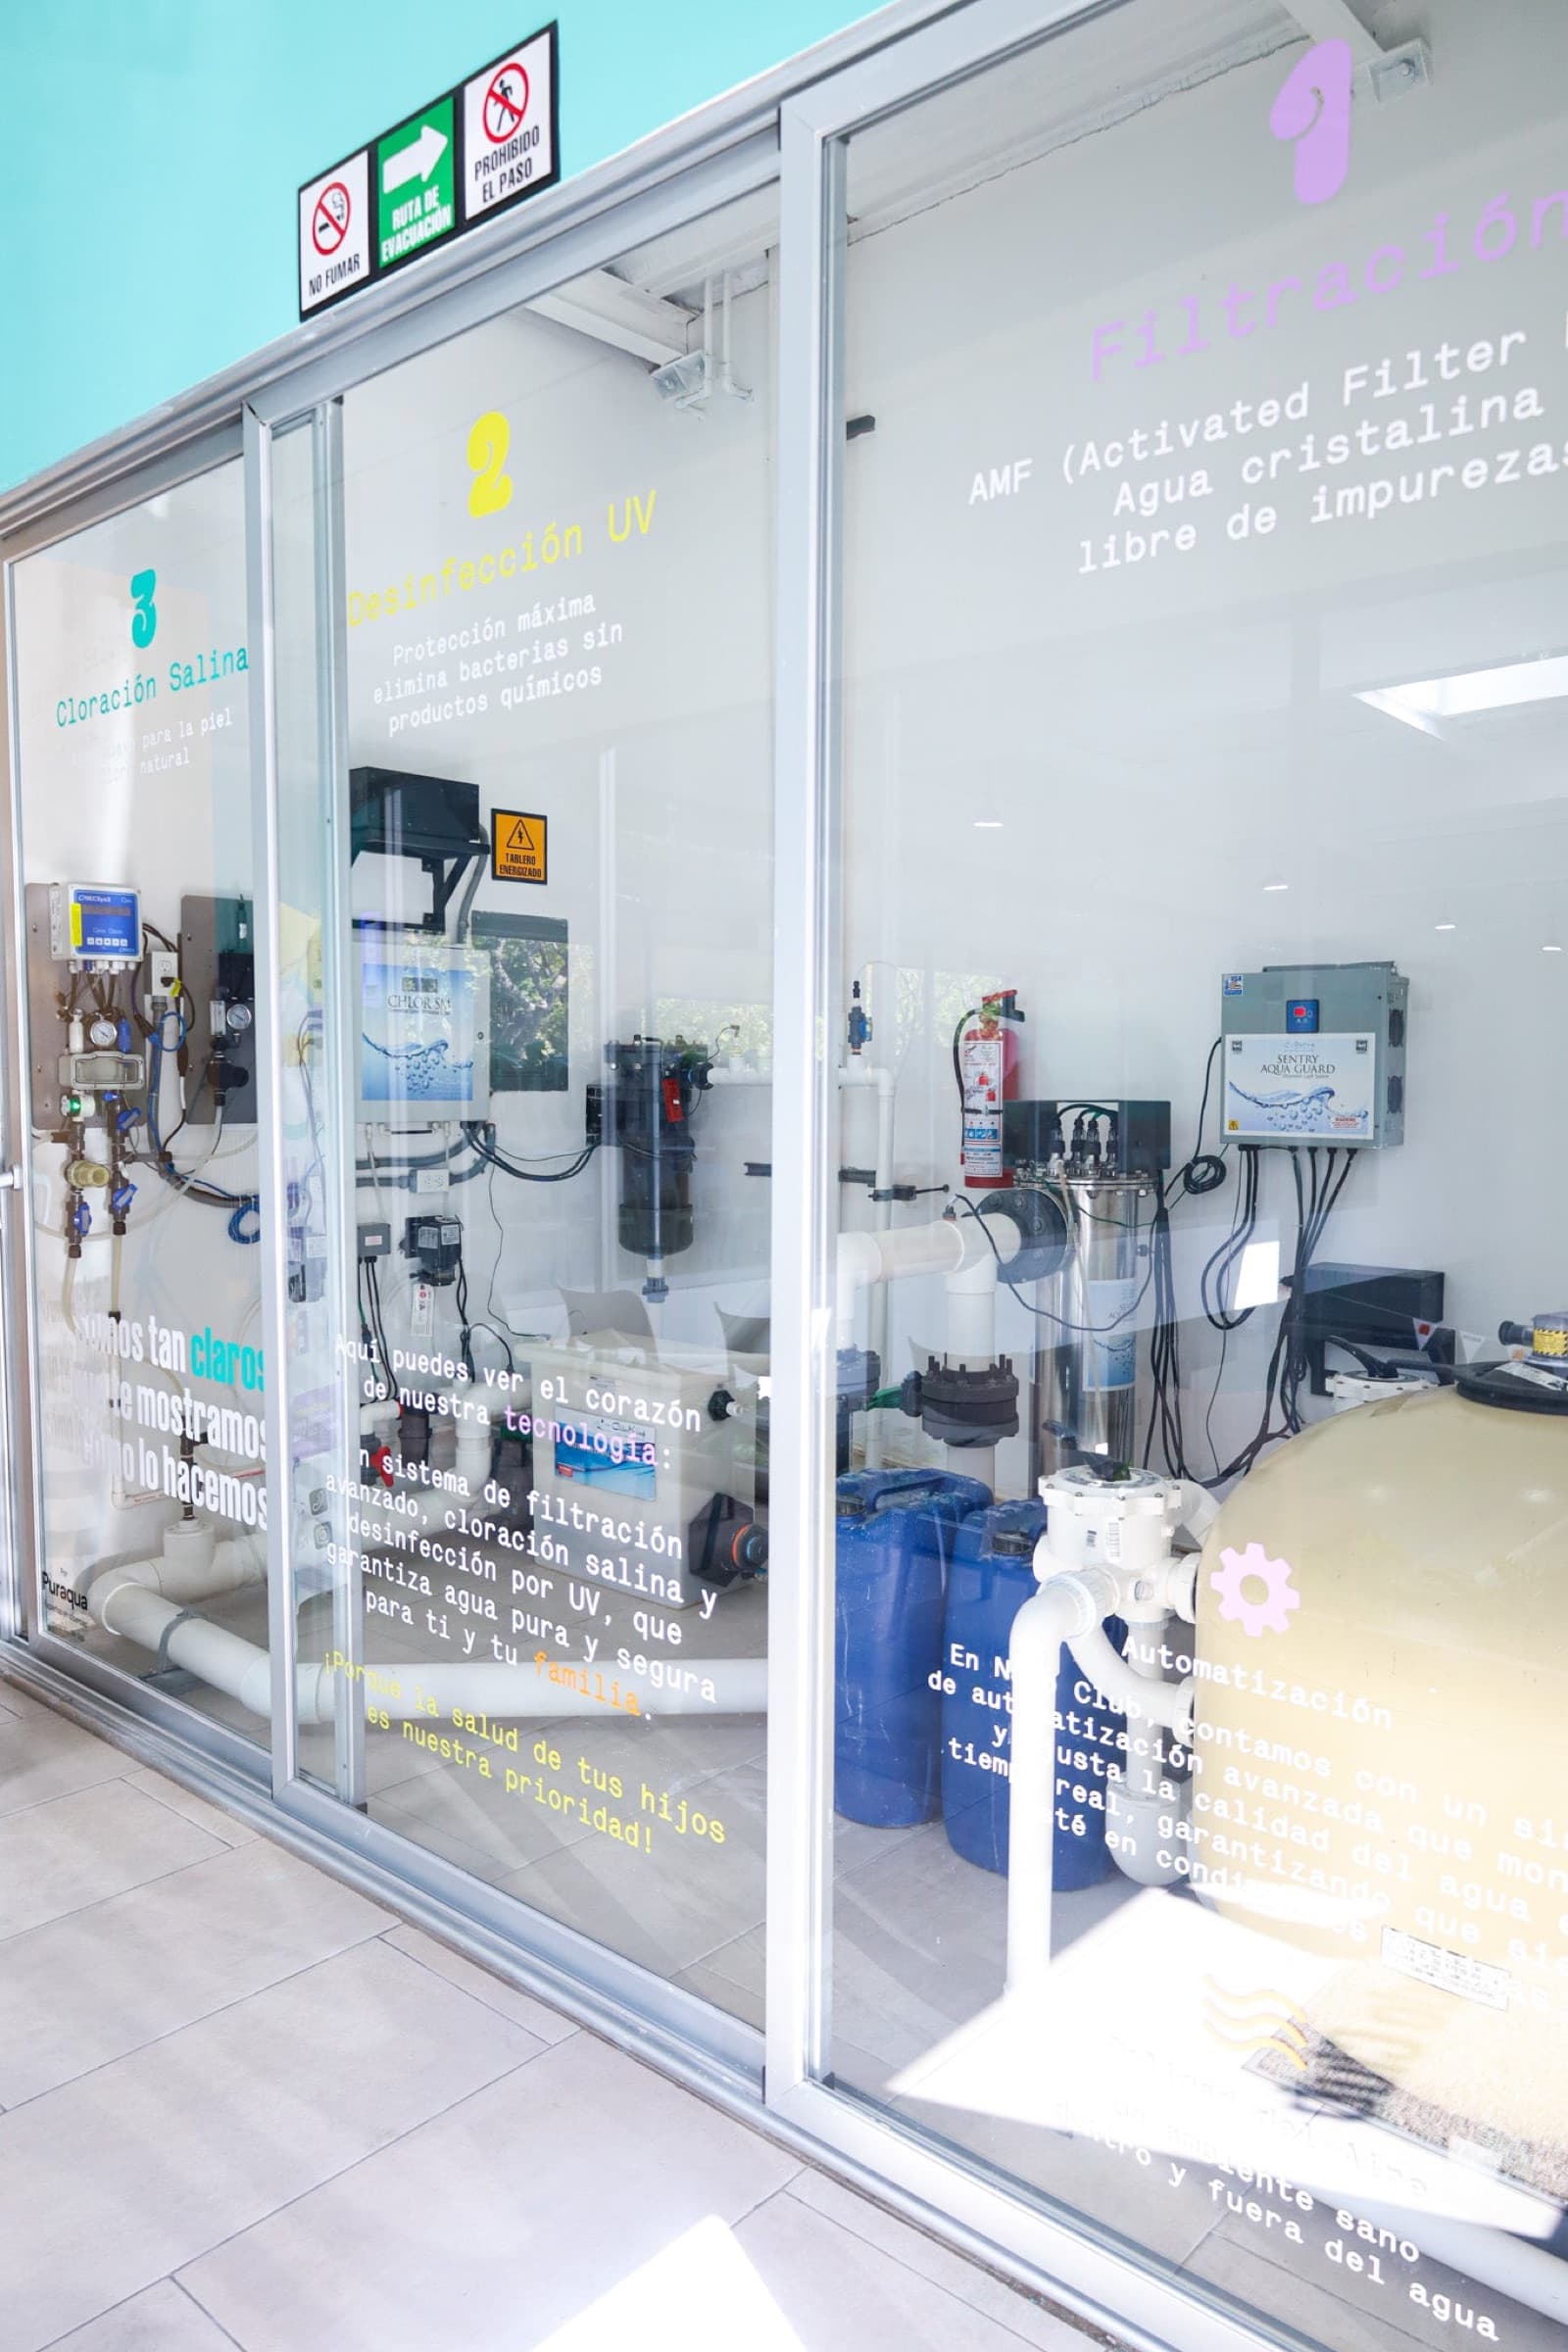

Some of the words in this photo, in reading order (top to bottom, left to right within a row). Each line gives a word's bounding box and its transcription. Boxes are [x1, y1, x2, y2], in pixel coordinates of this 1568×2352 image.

[474, 124, 540, 181] PROHIBIDO
[1271, 39, 1351, 204] 1
[393, 196, 421, 232] RUTA
[424, 184, 439, 212] DE
[483, 180, 495, 203] EL
[500, 157, 532, 197] PASO
[309, 273, 321, 297] NO
[325, 254, 360, 285] FUMAR
[382, 204, 452, 262] EVACUACIÓN
[1090, 190, 1568, 381] Filtración
[968, 459, 1033, 505] AMF
[1063, 383, 1308, 485] (Activated
[1344, 330, 1526, 406] Filter
[1113, 469, 1213, 517] Agua
[1242, 387, 1544, 478] cristalina
[466, 411, 514, 518] 2
[348, 521, 583, 627] Desinfección
[608, 489, 657, 543] UV
[1079, 524, 1197, 574] libre
[1226, 504, 1278, 540] de
[130, 568, 157, 649] 3
[393, 617, 506, 667] Protección
[517, 593, 596, 632] máxima
[57, 673, 157, 727] Cloración
[169, 646, 249, 692] Salina
[373, 670, 447, 705] elimina
[460, 638, 568, 682] bacterias
[583, 621, 623, 651] sin
[389, 693, 488, 737] productos
[501, 665, 602, 710] químicos
[140, 747, 189, 775] natural
[142, 728, 172, 752] para
[179, 720, 193, 739] la
[200, 708, 233, 739] piel
[500, 864, 542, 878] ENERGIZADO
[506, 853, 536, 865] TABLERO
[1260, 1063, 1291, 1075] AQUA
[1294, 1063, 1336, 1074] GUARD
[1278, 1054, 1319, 1064] SENTRY
[78, 1313, 143, 1361] omos
[149, 1315, 186, 1373] tan
[335, 1334, 381, 1364] Aquí
[394, 1349, 468, 1384] puedes
[484, 1365, 524, 1394] ver
[540, 1376, 568, 1404] el
[586, 1389, 701, 1433] corazón
[364, 1376, 386, 1399] de
[400, 1387, 490, 1426] nuestra
[505, 1405, 670, 1470] tecnología:
[139, 1438, 158, 1491] lo
[163, 1445, 268, 1531] hacemos
[382, 1447, 470, 1497] sistema
[483, 1478, 511, 1508] de
[526, 1490, 682, 1560] filtración
[42, 1571, 87, 1610] Puraqua
[325, 1473, 428, 1526] avanzado,
[445, 1498, 568, 1566] cloración
[586, 1551, 684, 1604] salina
[700, 1589, 717, 1620] y
[350, 1512, 496, 1582] desinfección
[512, 1569, 554, 1599] por
[568, 1583, 612, 1626] UV,
[633, 1610, 683, 1644] que
[326, 1544, 432, 1596] garantiza
[445, 1584, 498, 1620] agua
[513, 1608, 569, 1647] pura
[584, 1635, 599, 1663] y
[617, 1647, 717, 1703] segura
[366, 1590, 415, 1626] para
[426, 1609, 451, 1639] ti
[462, 1628, 476, 1655] y
[491, 1636, 518, 1666] tu
[534, 1650, 653, 1721] familia.
[1121, 1636, 1393, 1730] Automatización
[368, 1704, 390, 1731] es
[403, 1722, 493, 1779] nuestra
[506, 1768, 653, 1854] prioridad!
[416, 1686, 440, 1717] la
[452, 1704, 518, 1753] salud
[533, 1740, 563, 1772] de
[578, 1757, 623, 1799] tus
[641, 1784, 726, 1844] hijos
[927, 1670, 956, 1695] de
[1223, 1765, 1385, 1835] avanzada
[1406, 1823, 1474, 1862] que
[950, 1643, 979, 1671] En
[1073, 1682, 1155, 1727] Club,
[1179, 1716, 1333, 1779] contamos
[1354, 1768, 1418, 1804] con
[1444, 1791, 1488, 1827] un
[1512, 1813, 1568, 1848] si
[991, 1724, 1007, 1748] y
[1142, 1769, 1176, 1802] la
[1195, 1790, 1331, 1852] calidad
[1352, 1841, 1414, 1883] del
[1441, 1873, 1531, 1923] agua
[1056, 1779, 1135, 1825] real,
[1157, 1814, 1393, 1913] garantizando
[1414, 1905, 1480, 1944] que
[1104, 1829, 1137, 1856] en
[1168, 2161, 1186, 2188] y
[1208, 2178, 1304, 2246] fuera
[1324, 2237, 1386, 2286] del
[1408, 2278, 1500, 2343] agua
[1337, 2206, 1420, 2265] sano
